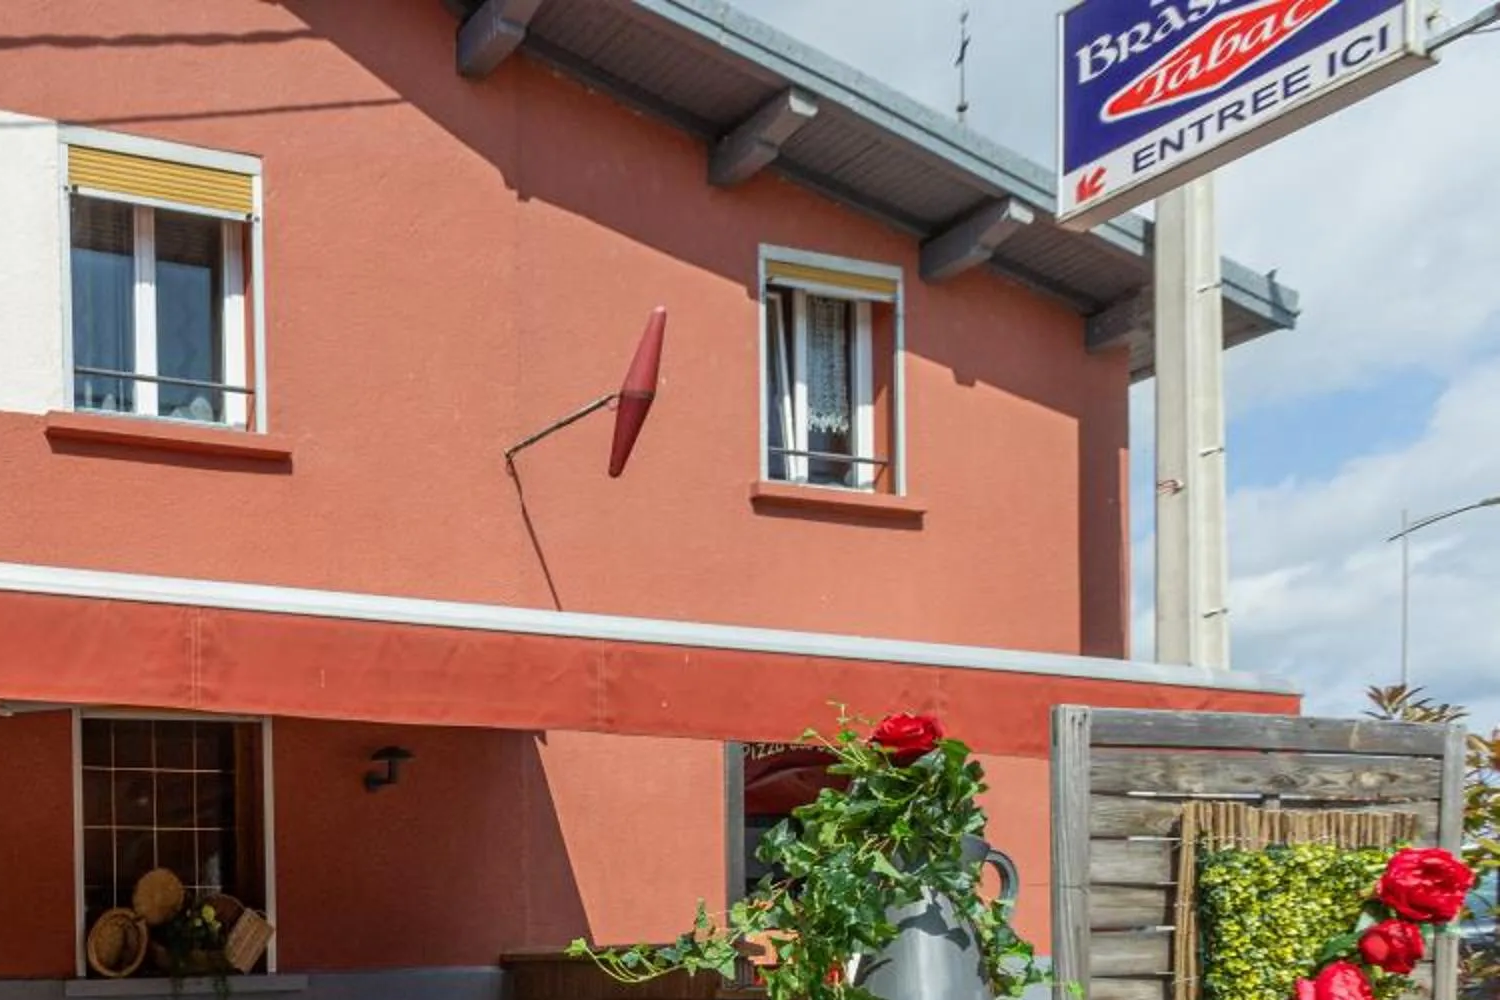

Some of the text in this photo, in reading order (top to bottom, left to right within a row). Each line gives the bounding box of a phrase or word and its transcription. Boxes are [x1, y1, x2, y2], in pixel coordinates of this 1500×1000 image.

[1132, 26, 1390, 174] ENTREE ICI
[1134, 0, 1324, 104] Tabac
